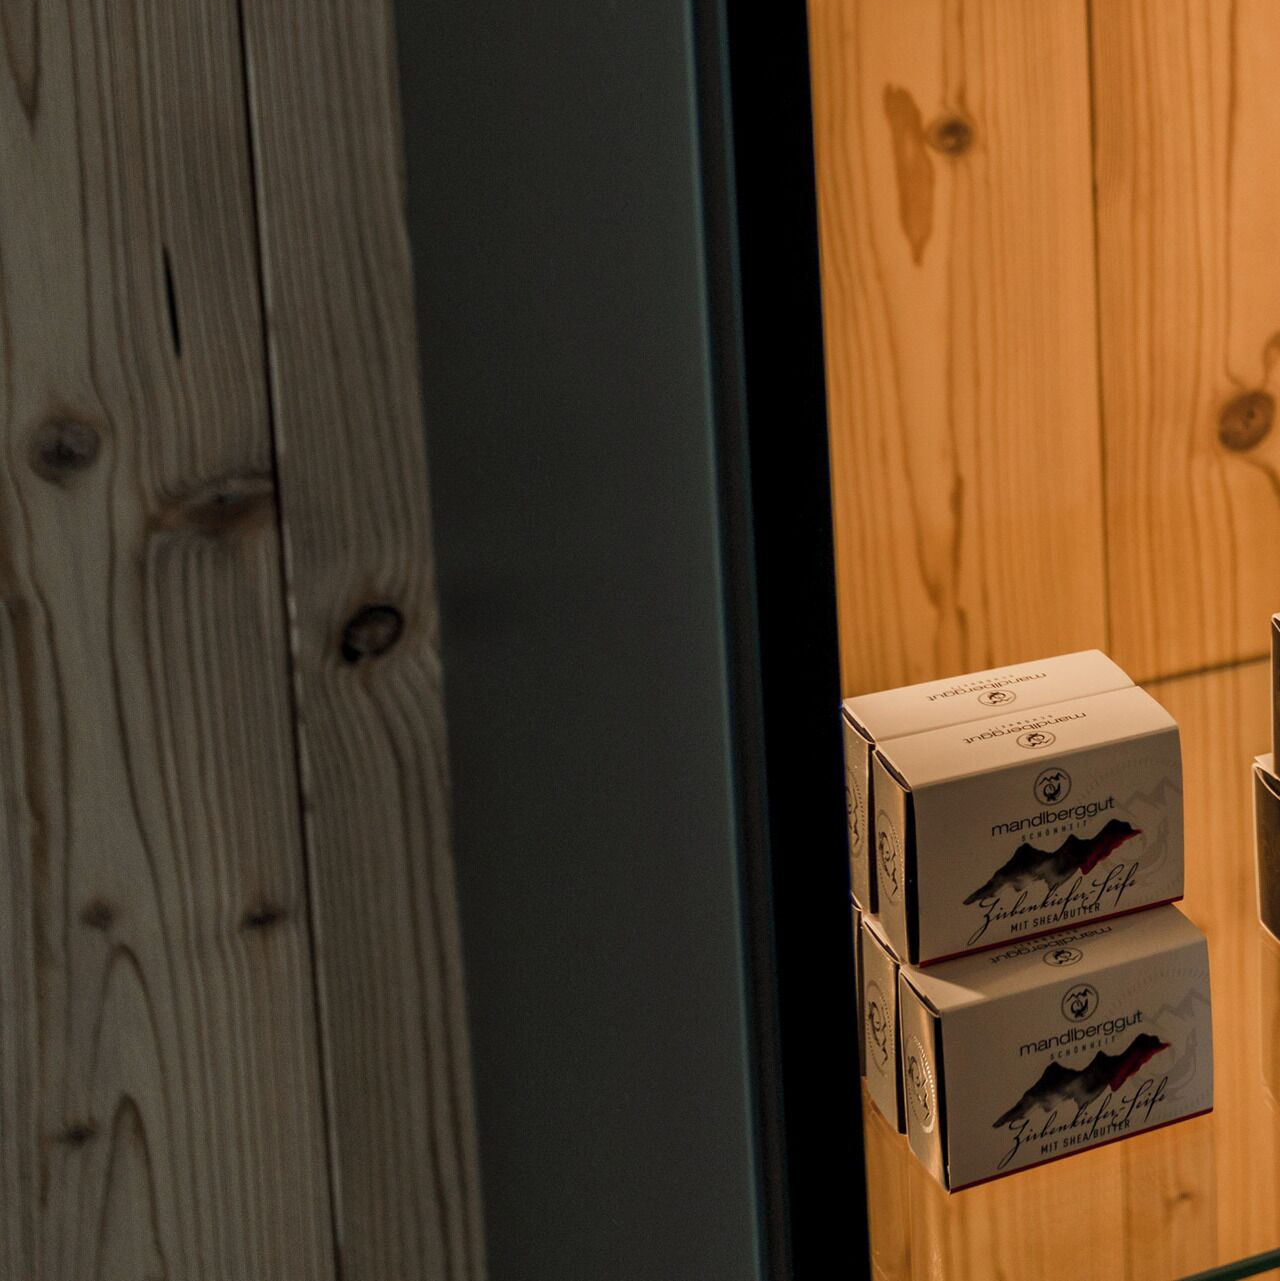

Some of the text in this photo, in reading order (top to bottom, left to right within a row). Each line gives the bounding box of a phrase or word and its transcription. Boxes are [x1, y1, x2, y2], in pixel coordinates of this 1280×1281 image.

[991, 796, 1115, 837] mandlberggut
[1010, 902, 1101, 933] MIT SHEA BUTTER
[1020, 1009, 1143, 1057] mandlberggut
[1040, 1120, 1131, 1154] MIT SHEA BUTTER
